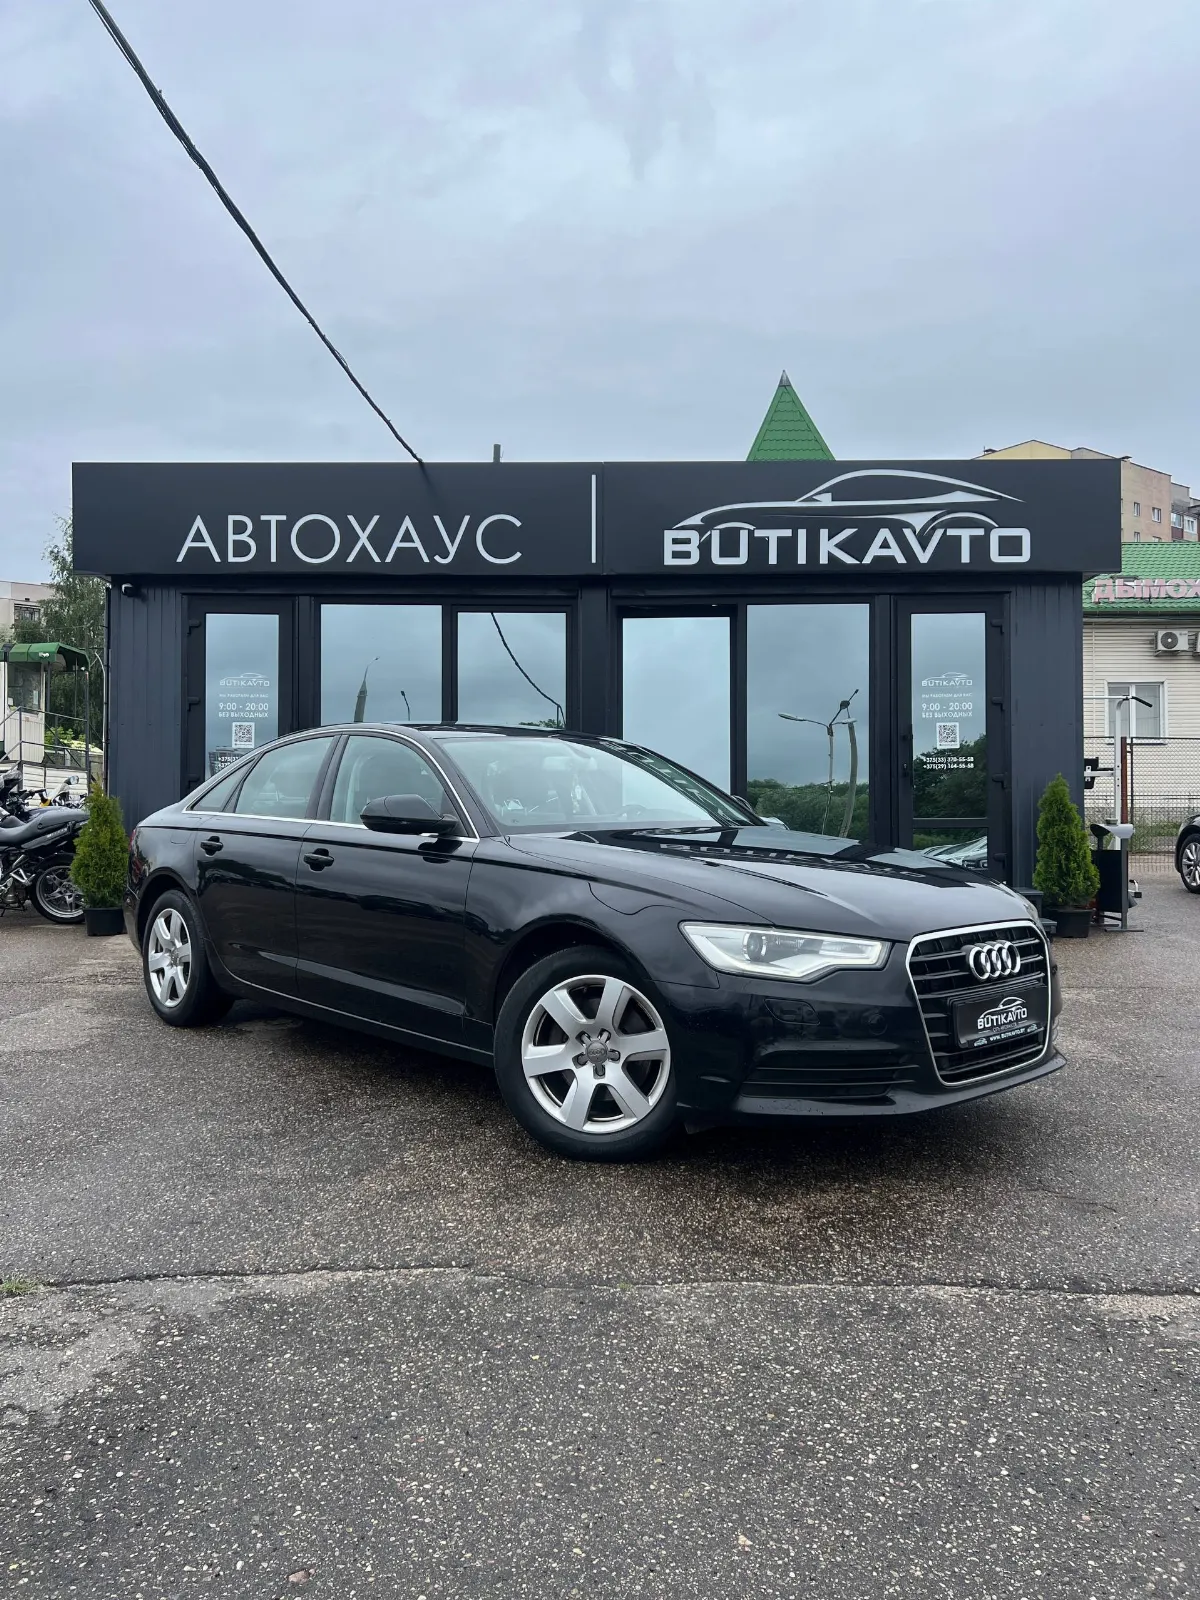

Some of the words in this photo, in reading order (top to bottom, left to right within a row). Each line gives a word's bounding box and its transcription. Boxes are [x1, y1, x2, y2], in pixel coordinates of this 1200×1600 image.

[176, 513, 523, 564] АВТОХАУС
[663, 527, 1031, 566] BUTIKAVTO
[219, 702, 236, 710] 9:00
[949, 702, 972, 710] 20:00
[977, 1008, 1027, 1029] BUTIKAVTO
